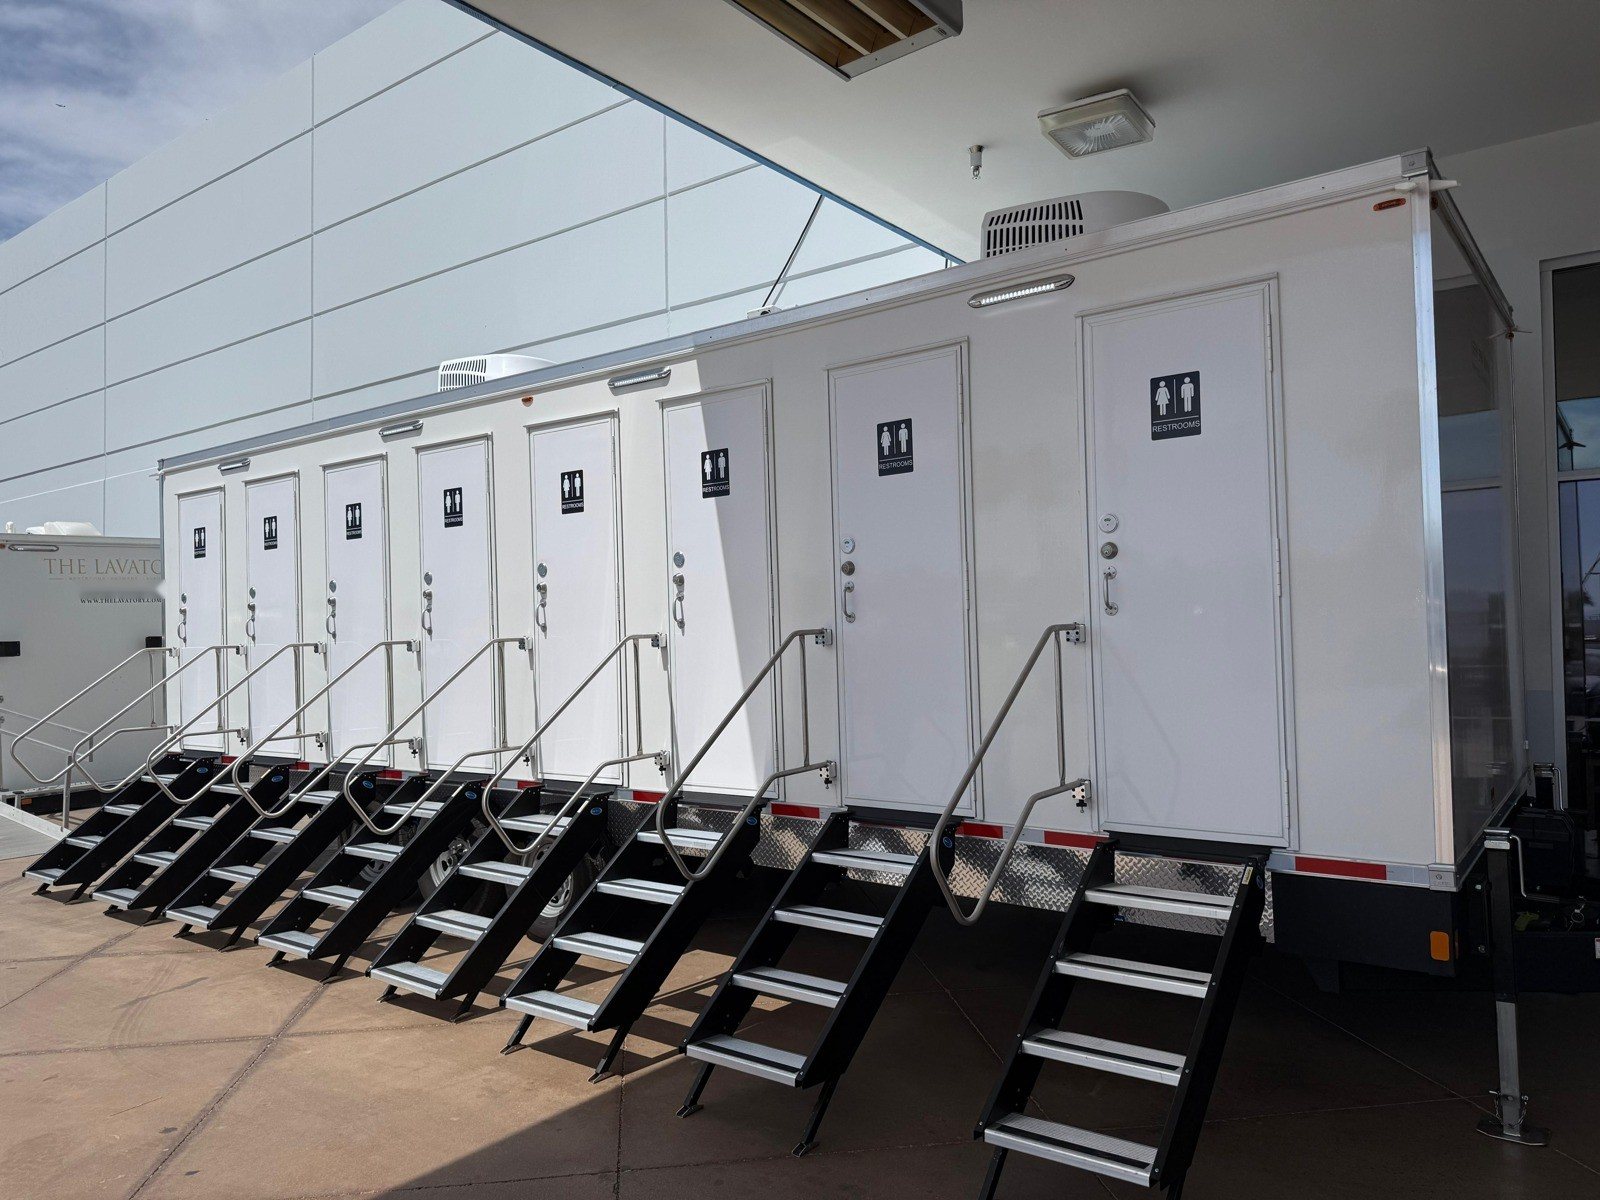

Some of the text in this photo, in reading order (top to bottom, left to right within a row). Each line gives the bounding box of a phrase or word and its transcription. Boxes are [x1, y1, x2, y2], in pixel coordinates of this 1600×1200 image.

[1152, 420, 1200, 432] RESTROOMS
[879, 460, 913, 470] RESTROOMS
[702, 485, 730, 493] RESTROOMS
[44, 558, 86, 575] THE
